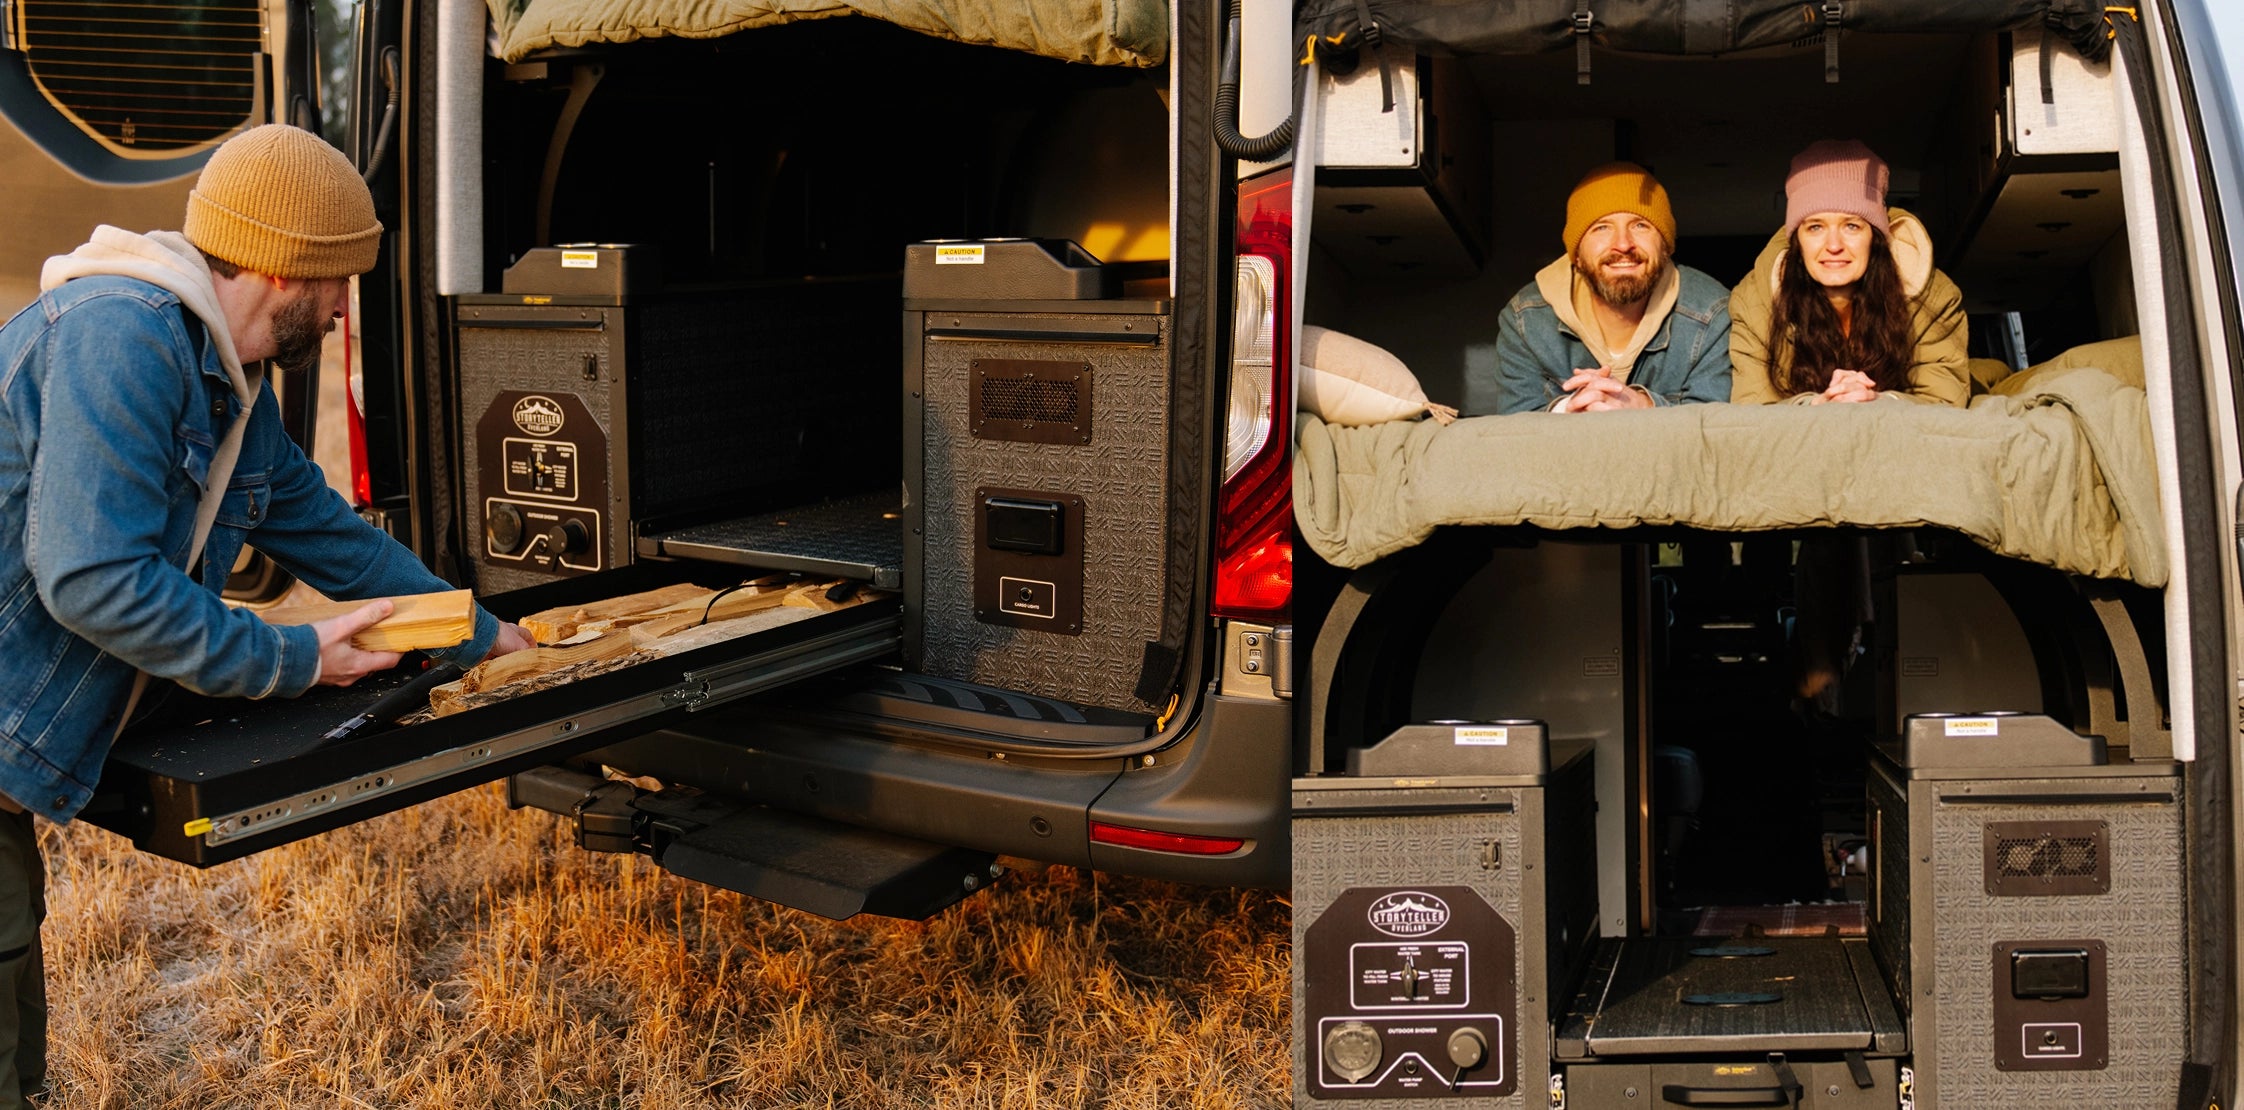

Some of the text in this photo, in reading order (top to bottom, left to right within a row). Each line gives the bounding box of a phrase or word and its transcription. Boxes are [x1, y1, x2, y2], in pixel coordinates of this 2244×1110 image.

[516, 412, 560, 424] STORYTELLER
[1373, 910, 1445, 923] STORYTELLER
[1391, 924, 1427, 932] OVERLAND
